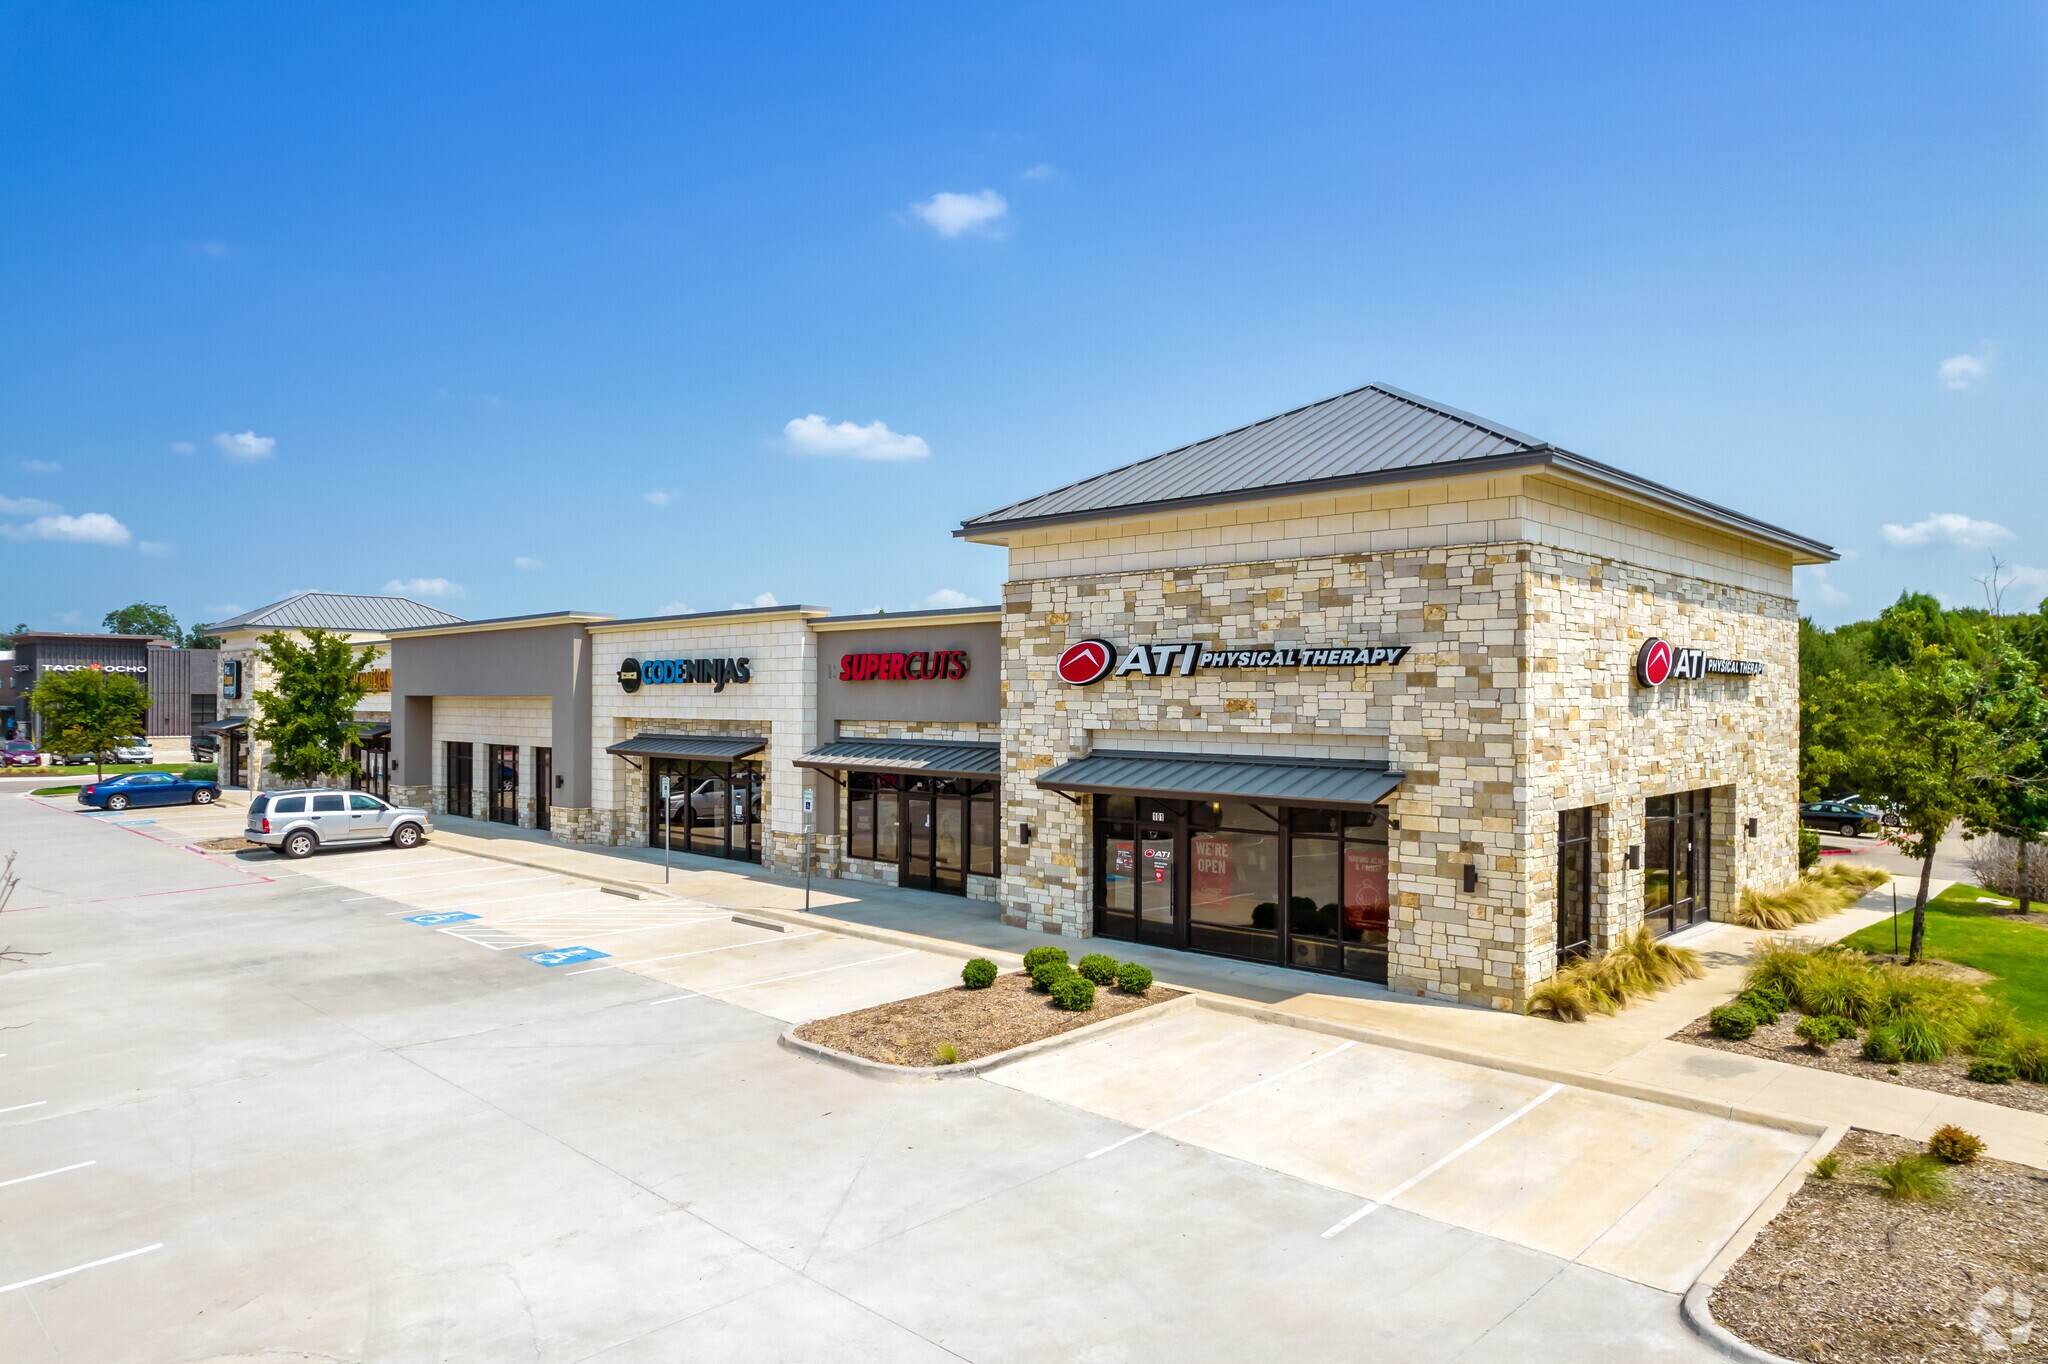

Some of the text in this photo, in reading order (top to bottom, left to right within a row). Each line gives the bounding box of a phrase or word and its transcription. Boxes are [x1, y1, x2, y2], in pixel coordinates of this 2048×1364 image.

[839, 650, 967, 681] SUPERCUTS
[1115, 644, 1407, 676] ATI PHYSICAL THERAPY
[1674, 648, 1766, 679] ATI PHYSICAL THERAPY
[104, 665, 147, 673] OCHO
[1154, 850, 1170, 858] ATI
[1196, 842, 1228, 857] WE'RE
[1198, 859, 1226, 874] OPEN
